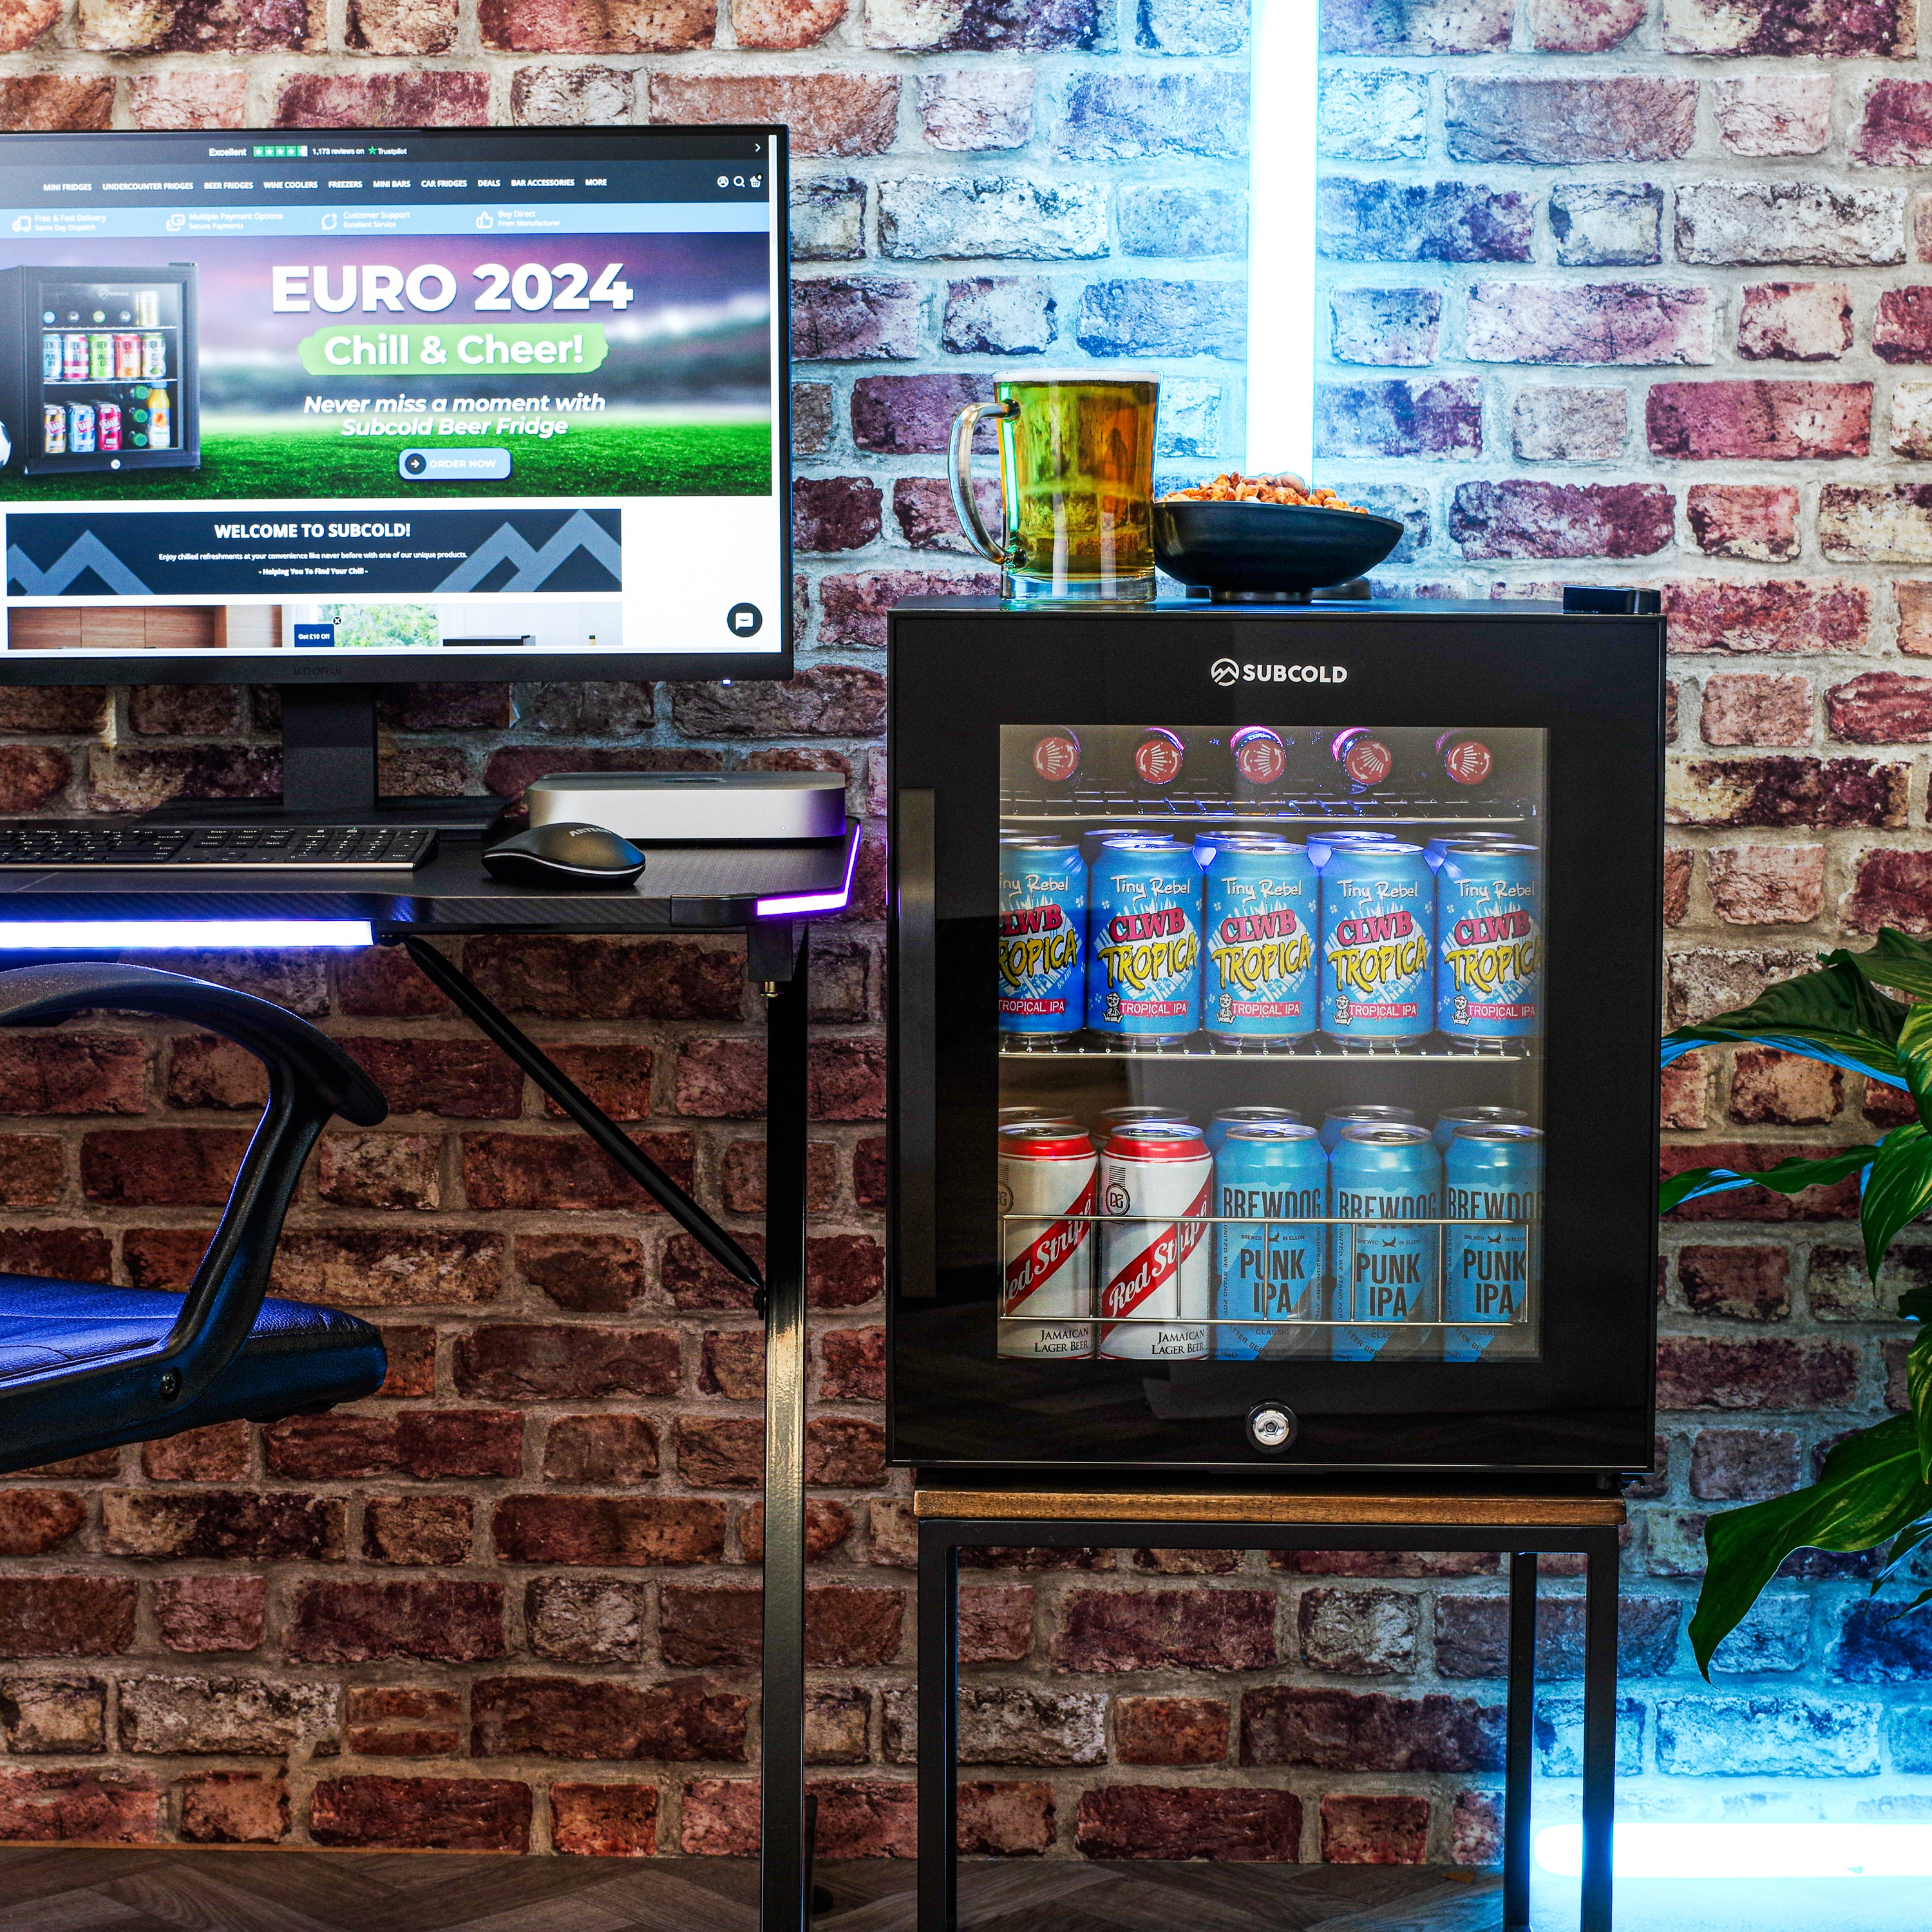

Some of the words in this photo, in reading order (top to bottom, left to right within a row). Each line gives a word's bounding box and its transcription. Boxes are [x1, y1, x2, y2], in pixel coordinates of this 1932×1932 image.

[209, 148, 247, 156] Excellent
[527, 178, 575, 187] ACCESSORIES
[77, 214, 107, 223] Delivery
[189, 213, 219, 221] Multiple
[220, 213, 252, 222] Payment
[254, 212, 283, 221] Options
[381, 211, 410, 220] Support
[498, 211, 512, 219] Buy
[66, 223, 97, 232] Dispatch
[212, 223, 244, 231] Payments
[272, 264, 457, 313] EURO
[473, 263, 634, 312] 2024
[325, 333, 409, 366] Chill
[420, 335, 448, 366] &
[457, 334, 583, 365] Cheer!
[303, 395, 371, 414] Never
[375, 393, 426, 413] miss
[431, 399, 447, 413] a
[453, 394, 550, 413] moment
[555, 392, 606, 412] with
[341, 417, 433, 437] Subcold
[438, 418, 491, 436] Beer
[496, 416, 569, 439] Fridge
[429, 460, 467, 469] ORDER
[469, 459, 497, 468] NOW
[214, 524, 298, 538] WELCOME
[301, 524, 325, 538] TO
[328, 523, 411, 537] SUBCOLD!
[159, 553, 176, 562] Enjoy
[437, 551, 468, 560] products.
[263, 568, 289, 576] Helping
[1242, 664, 1348, 683] SUBCOLD
[999, 872, 1023, 902] iny
[1025, 874, 1069, 895] Rebel
[1110, 875, 1147, 906] Tiny
[1150, 877, 1190, 899] Rebel
[1221, 876, 1256, 908] Tiny
[1259, 878, 1302, 900] Rebel
[1337, 879, 1373, 910] Tiny
[1375, 881, 1418, 902] Rebel
[1454, 879, 1491, 910] Tiny
[1493, 880, 1535, 902] Rebel
[1110, 907, 1185, 943] CLWB
[1222, 909, 1297, 945] CLWB
[1338, 911, 1413, 947] CLWB
[1454, 910, 1531, 947] CLWB
[999, 929, 1077, 987] ROPICA
[1097, 933, 1198, 990] TROPICA
[1211, 934, 1311, 992] TROPICA
[1327, 935, 1427, 993] TROPICA
[1064, 967, 1072, 980] ABV
[1050, 1001, 1065, 1011] IPA
[1120, 1003, 1170, 1014] TROPICAL
[1173, 1003, 1187, 1013] IPA
[1233, 1003, 1282, 1015] TROPICAL
[1285, 1003, 1300, 1014] IPA
[1349, 1005, 1399, 1016] TROPICAL
[1403, 1005, 1417, 1015] IPA
[1468, 1005, 1518, 1017] TROPICAL
[1522, 1006, 1535, 1016] IPA
[1224, 1187, 1321, 1218] BREWDOG
[1340, 1191, 1436, 1228] BREWDOG
[1224, 1256, 1228, 1268] WE
[1240, 1248, 1305, 1280] PUNK
[1338, 1260, 1343, 1271] WE
[1357, 1253, 1421, 1284] PUNK
[1463, 1249, 1526, 1281] PUNK
[1005, 1260, 1034, 1305] ed
[1109, 1262, 1151, 1317] Red
[1254, 1282, 1293, 1313] IPA
[1370, 1287, 1408, 1316] IPA
[1476, 1283, 1514, 1314] IPA
[1040, 1327, 1089, 1343] JAMAICAN
[1157, 1329, 1205, 1345] JAMAICAN
[1034, 1342, 1068, 1353] LAGER
[1070, 1340, 1088, 1351] BEER
[1151, 1344, 1185, 1355] LAGER
[1187, 1342, 1204, 1353] BEER
